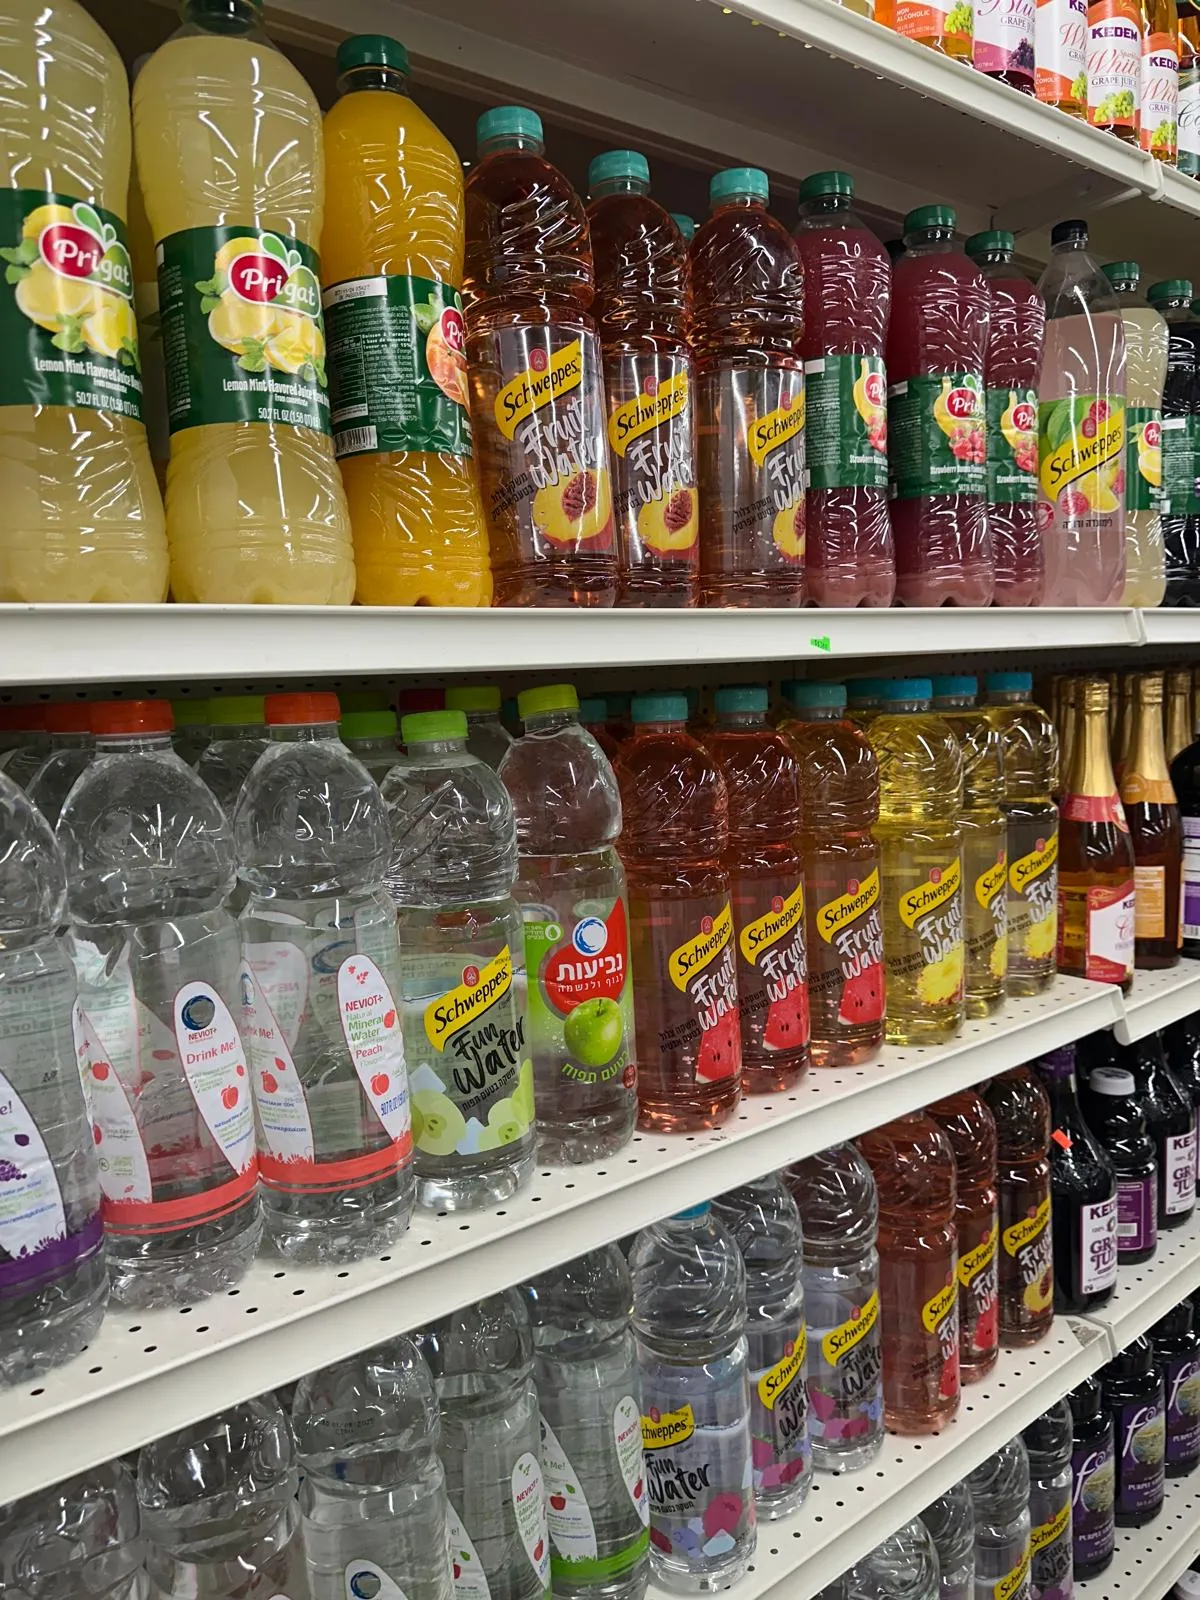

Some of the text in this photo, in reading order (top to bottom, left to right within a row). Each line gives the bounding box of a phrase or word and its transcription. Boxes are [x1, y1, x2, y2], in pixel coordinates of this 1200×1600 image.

[896, 10, 930, 23] ALCOHOLIC
[1092, 26, 1138, 41] KEDEM
[1092, 77, 1118, 87] GRAPE
[52, 239, 131, 287] Prigat
[239, 268, 316, 307] Prigat
[35, 357, 64, 372] Lemon
[65, 359, 86, 375] Mint
[86, 362, 116, 381] Flavored
[223, 379, 248, 392] Lemon
[249, 379, 267, 392] Mint
[268, 379, 298, 396] Flavored
[503, 359, 579, 422] Schweppes
[258, 408, 272, 420] 50.7
[1050, 427, 1122, 485] Schweppes
[824, 882, 877, 930] Schweppes
[906, 873, 959, 916] Schweppes
[748, 900, 801, 951] Schweppes
[836, 908, 882, 958] Fruit
[917, 896, 962, 943] Fruit
[677, 920, 730, 976] Schweppes
[760, 922, 806, 980] Fruit
[556, 953, 623, 982] נביעות
[691, 944, 735, 1007] Fruit
[434, 964, 509, 1034] Schweppes
[557, 980, 601, 993] ולנשמה
[345, 994, 384, 1012] NEVIOT+
[258, 1027, 275, 1040] Me!
[348, 1015, 384, 1031] Mineral
[351, 1028, 381, 1042] Water
[186, 1037, 237, 1065] Drink Me!
[355, 1045, 383, 1059] Peach
[452, 1023, 499, 1061] Fun
[453, 1016, 526, 1095] Water
[562, 1063, 597, 1083] תפוח
[641, 1417, 687, 1441] chweppes
[645, 1452, 676, 1477] Fun
[646, 1463, 711, 1504] Water
